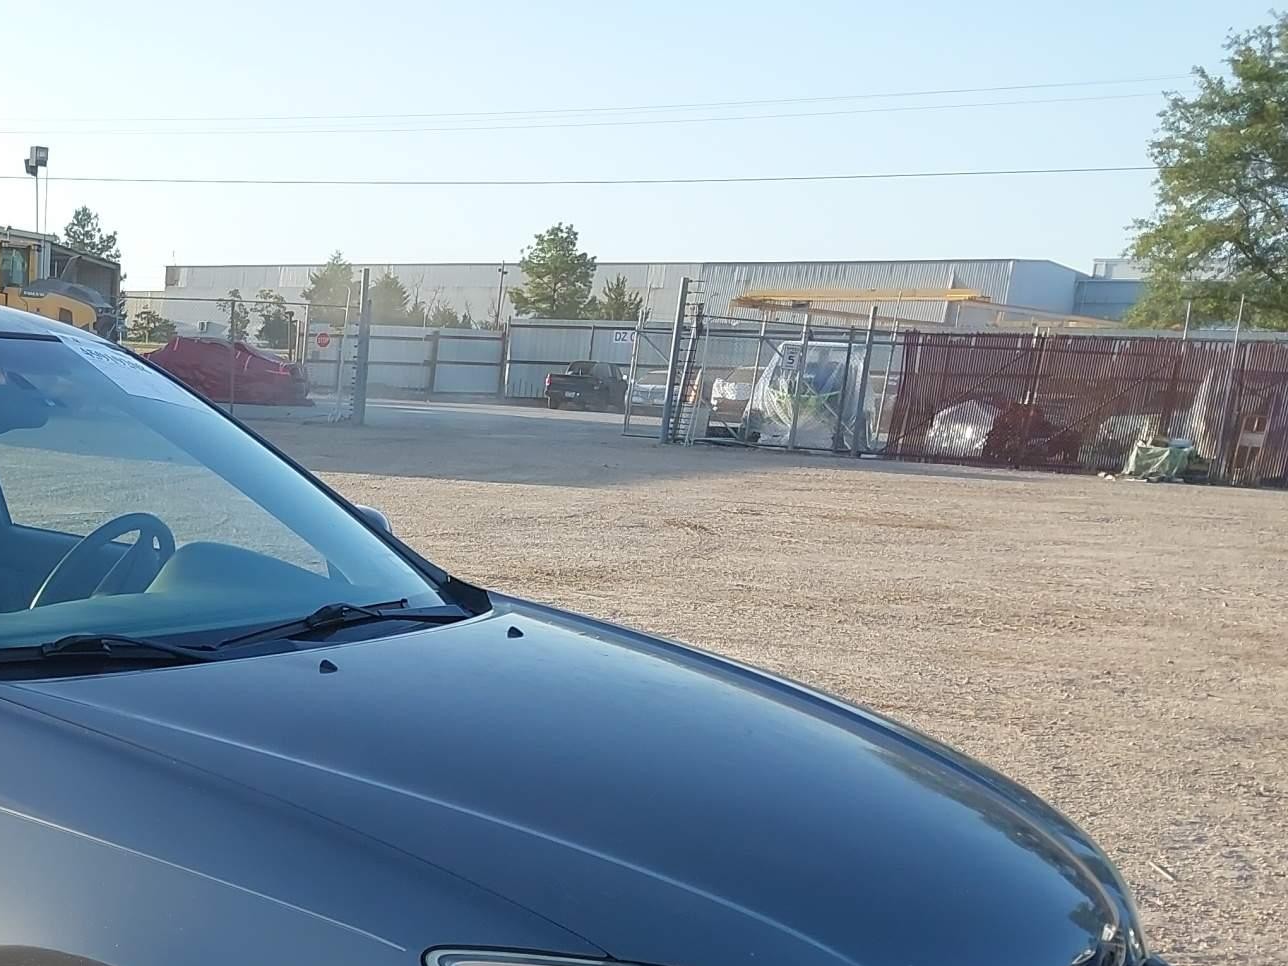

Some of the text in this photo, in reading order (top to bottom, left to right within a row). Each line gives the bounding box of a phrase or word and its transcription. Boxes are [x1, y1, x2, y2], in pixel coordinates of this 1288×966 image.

[317, 336, 329, 344] STOP
[614, 331, 628, 342] DZ
[787, 355, 795, 364] 5
